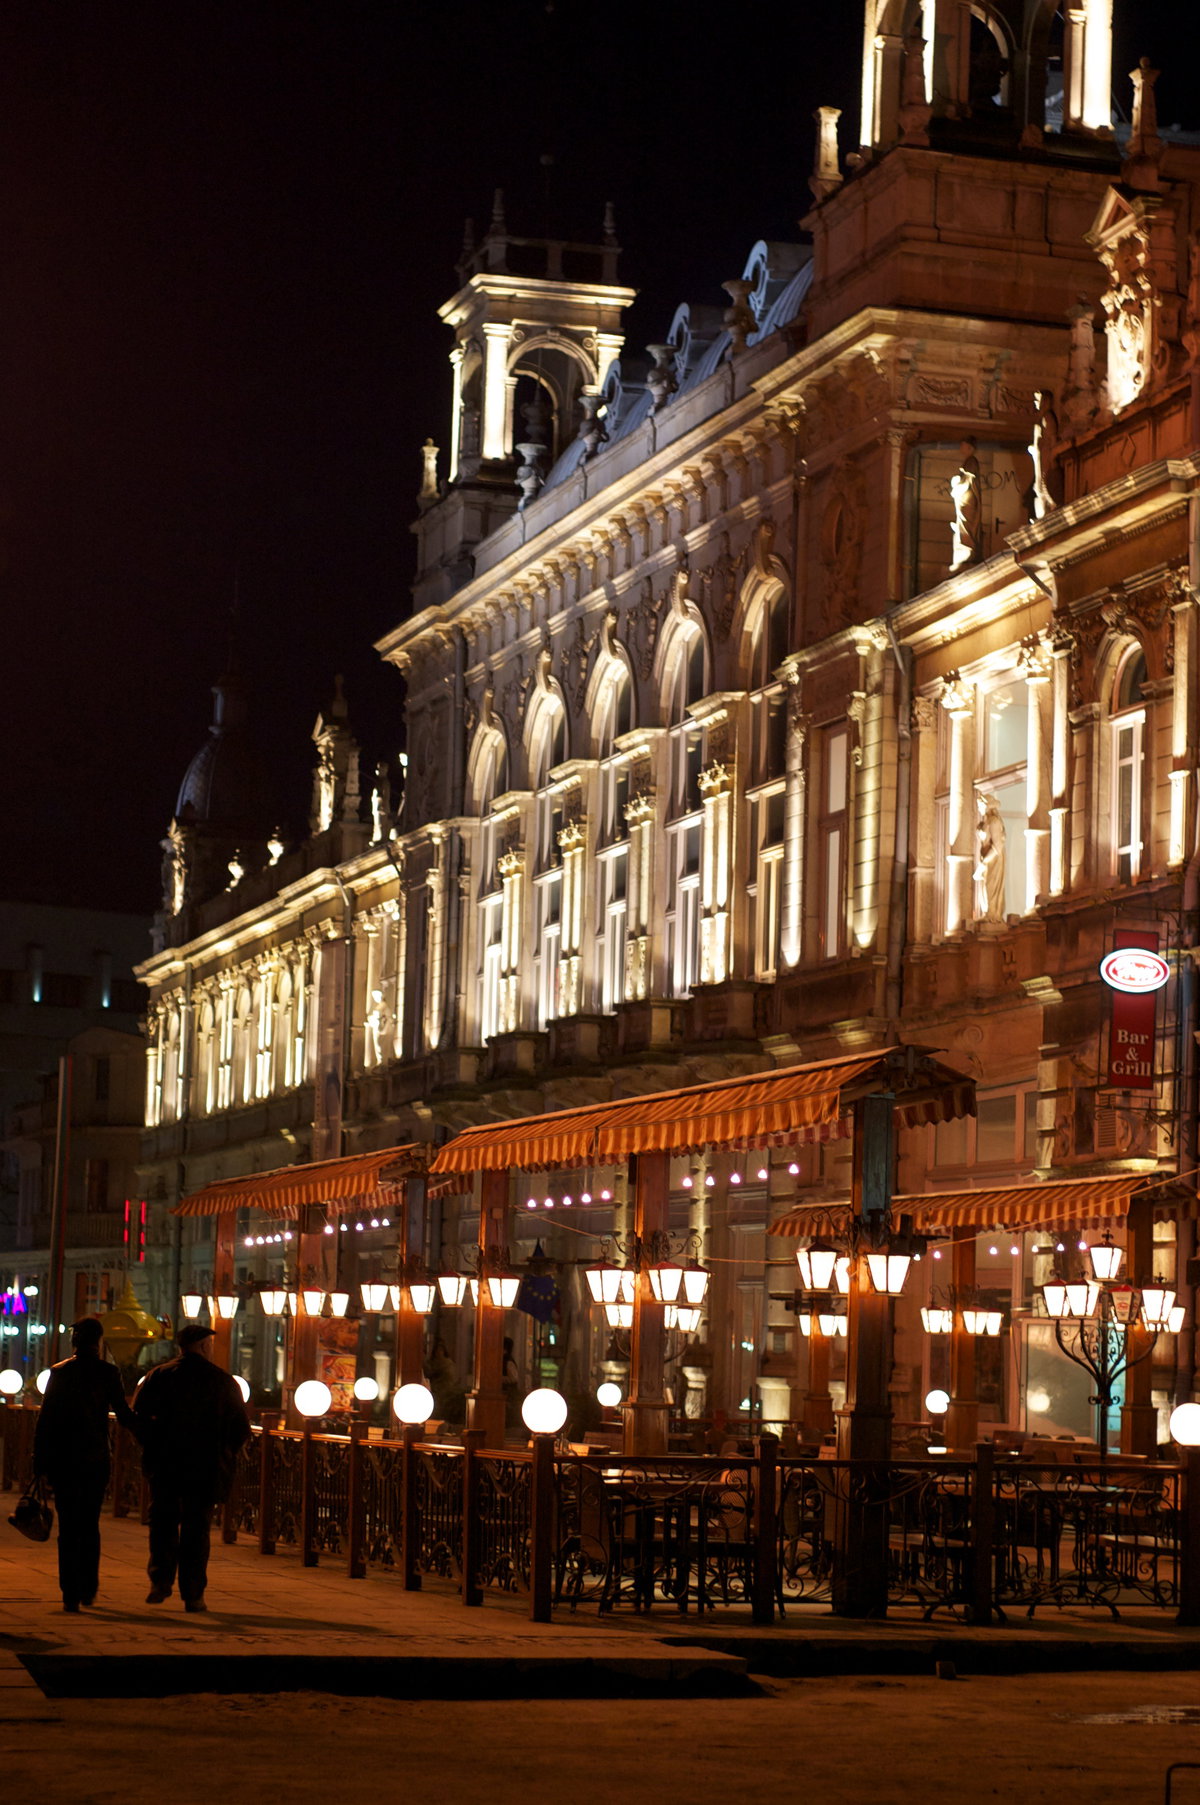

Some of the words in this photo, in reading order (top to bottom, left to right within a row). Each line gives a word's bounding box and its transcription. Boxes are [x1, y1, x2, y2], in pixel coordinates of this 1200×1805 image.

[1117, 1029, 1149, 1045] Bar
[1126, 1046, 1139, 1061] &
[1111, 1060, 1151, 1077] Grill
